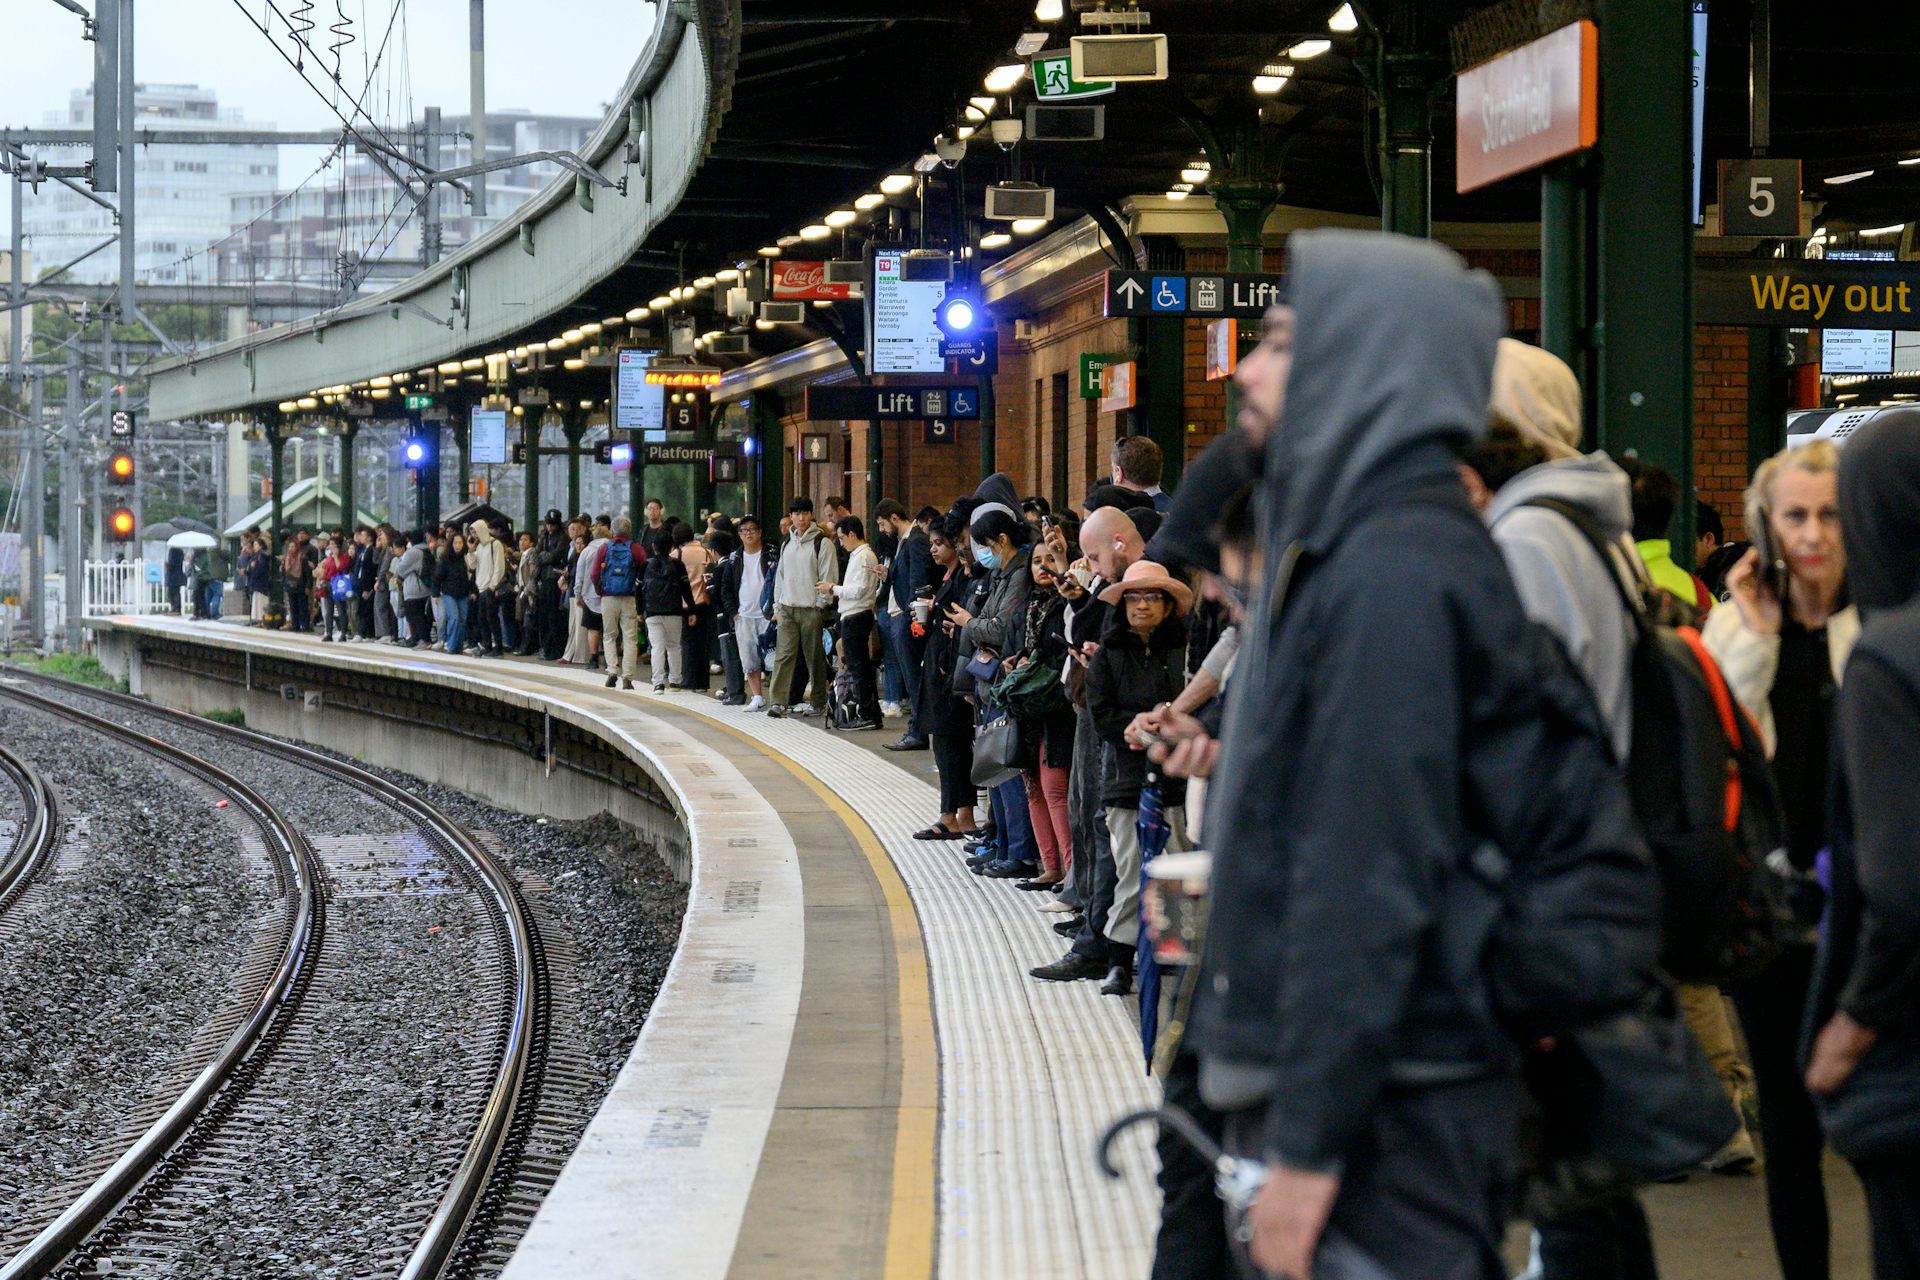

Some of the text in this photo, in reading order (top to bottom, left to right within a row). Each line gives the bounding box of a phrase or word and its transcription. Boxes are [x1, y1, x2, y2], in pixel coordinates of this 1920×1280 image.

[1748, 177, 1775, 217] 5
[880, 261, 890, 269] T9
[936, 290, 943, 298] 5
[1233, 282, 1280, 307] Lift
[1750, 274, 1912, 321] Way out
[1826, 330, 1855, 339] Thornleigh
[878, 393, 914, 412] Lift
[112, 411, 128, 434] S
[679, 409, 690, 425] 5
[933, 419, 946, 435] 5
[602, 447, 610, 458] 5
[649, 446, 714, 459] Platforms
[308, 695, 320, 708] 4
